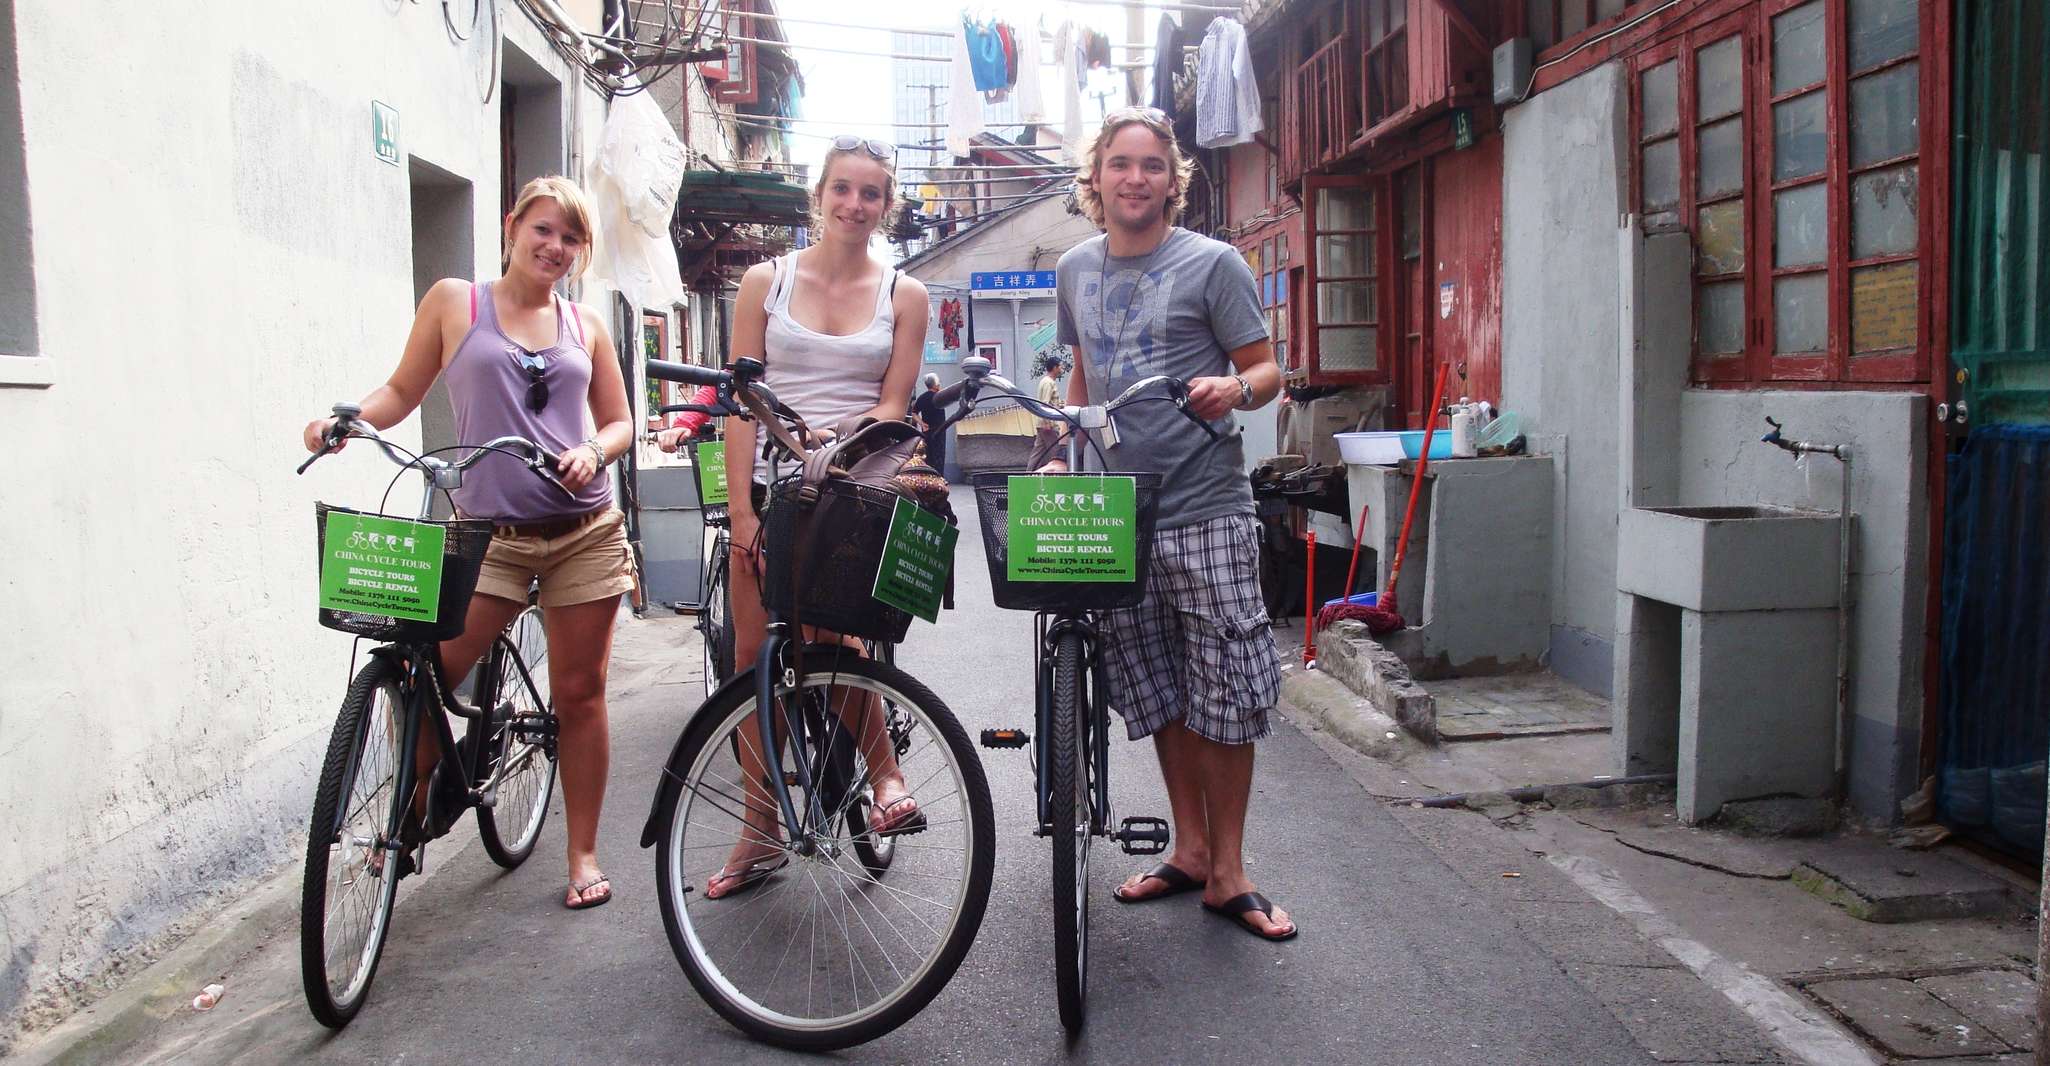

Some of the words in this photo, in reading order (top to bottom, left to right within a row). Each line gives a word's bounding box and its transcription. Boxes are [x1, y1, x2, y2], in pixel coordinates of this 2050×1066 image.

[993, 274, 1037, 287] 吉祥弄
[1020, 517, 1051, 527] CHINA
[1054, 517, 1089, 527] CYCLE
[1092, 517, 1125, 527] TOURS
[1036, 533, 1075, 541] BICYCLE
[1077, 533, 1109, 541] TOURS
[1036, 545, 1075, 553] BICYCLE
[1077, 545, 1114, 553] RENTAL
[335, 550, 365, 562] CHINA
[367, 554, 398, 566] CYCLE
[401, 558, 432, 570] TOURS
[348, 566, 385, 578] BICYCLE
[386, 571, 416, 582] TOURS
[1018, 567, 1127, 576] www.ChinaCycleTours.com
[347, 577, 384, 589] BICYCLE
[385, 582, 420, 594] RENTAL
[328, 596, 430, 615] www.ChinaCycleTours.com
